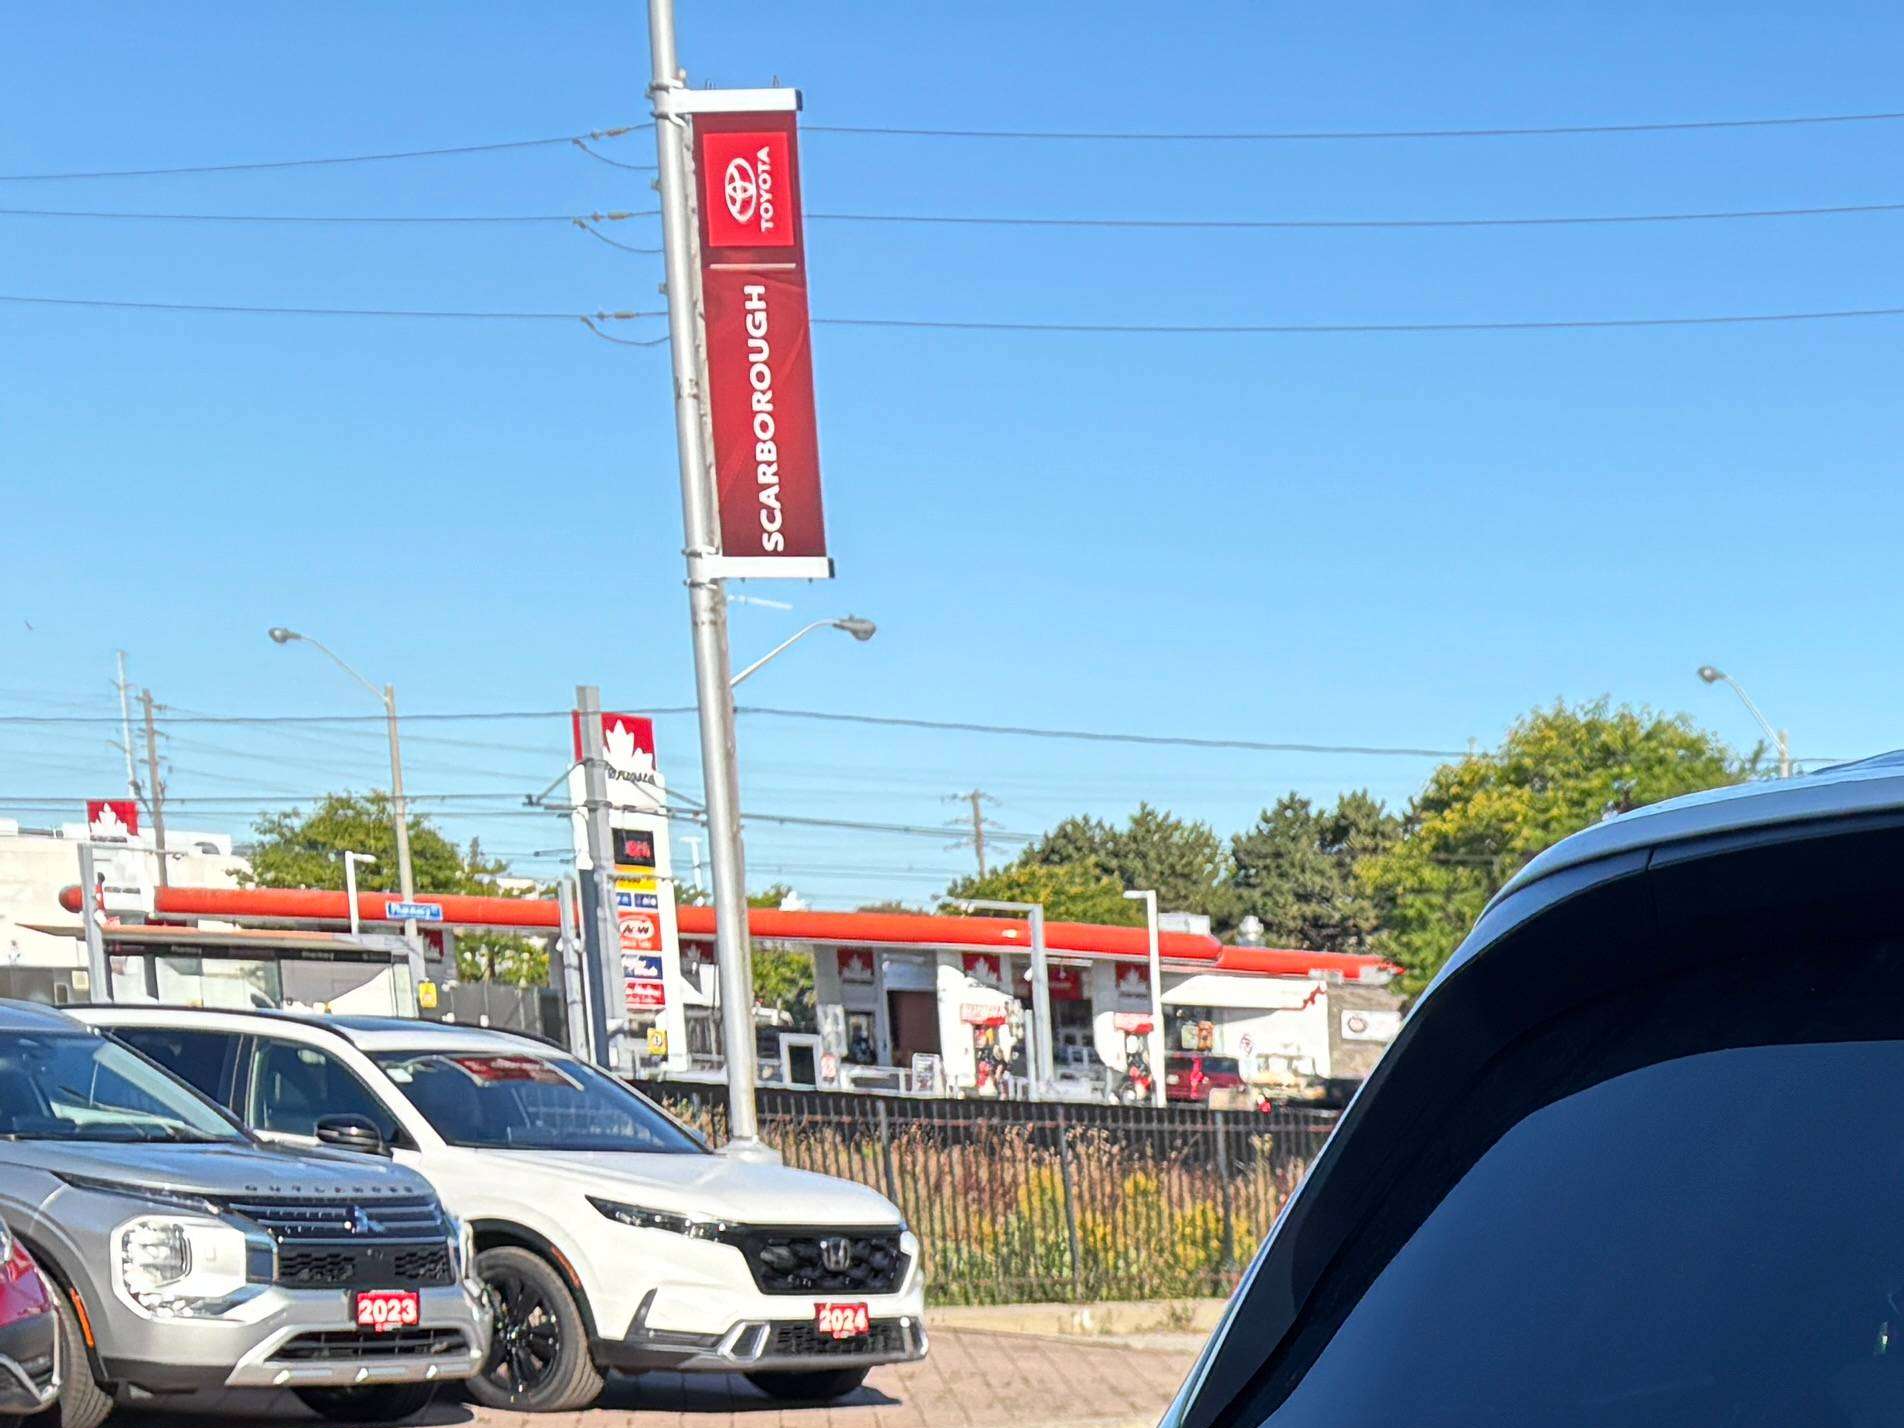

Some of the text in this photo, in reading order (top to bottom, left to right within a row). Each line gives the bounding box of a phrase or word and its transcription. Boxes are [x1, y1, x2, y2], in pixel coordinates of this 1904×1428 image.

[756, 146, 774, 232] TOYOTA
[744, 285, 784, 552] SCARBOROUGH
[358, 1298, 417, 1324] 2023
[819, 1307, 868, 1331] 2024
